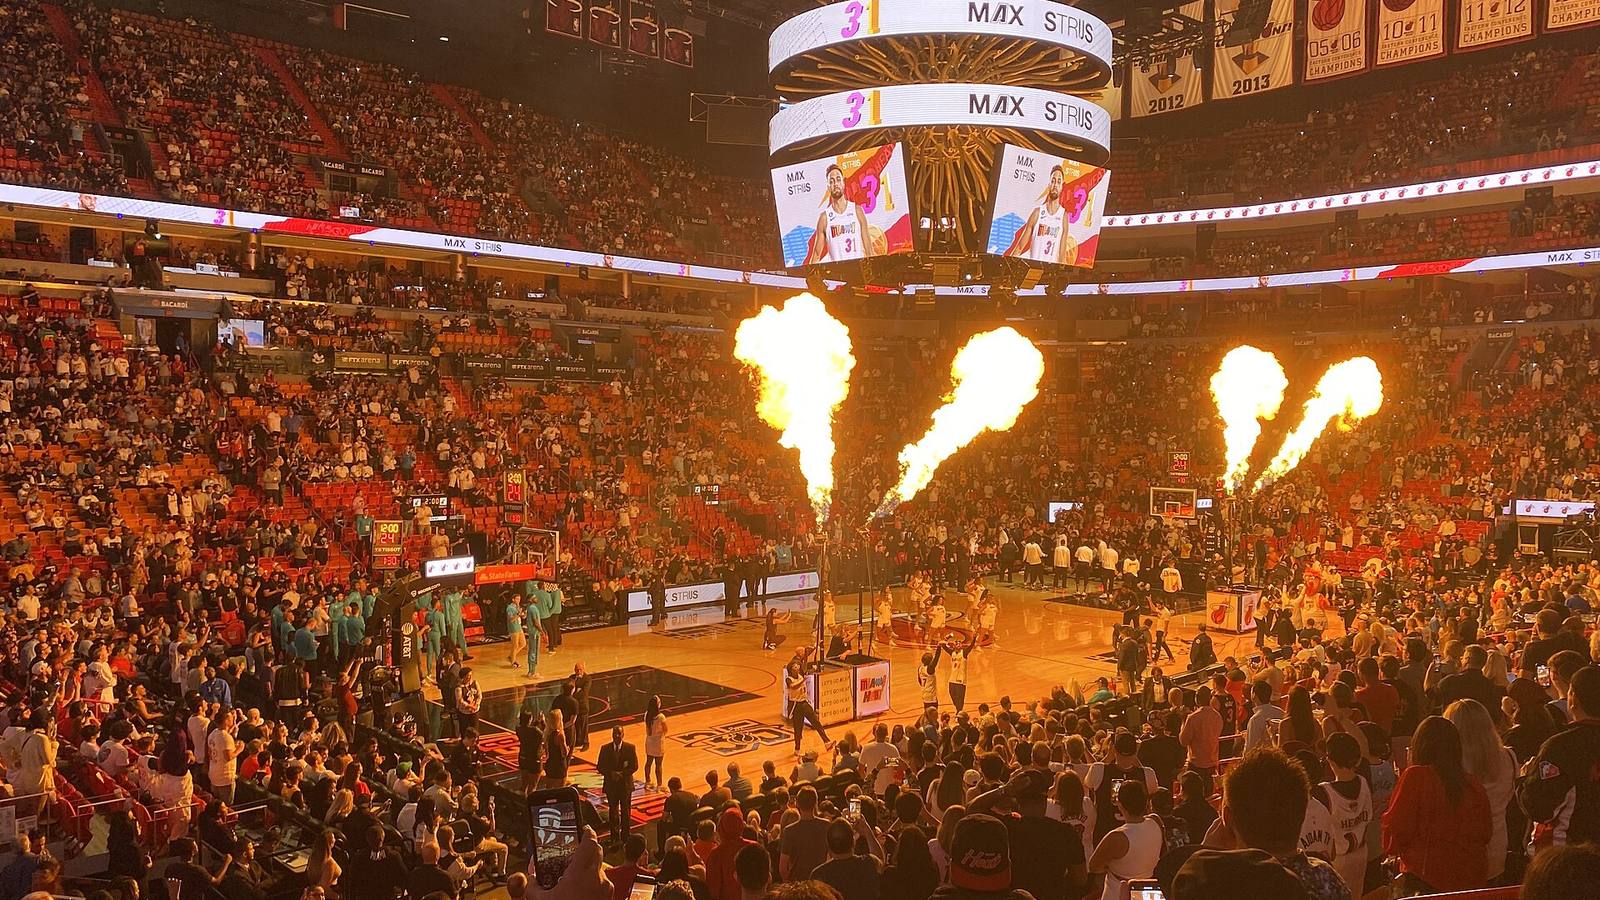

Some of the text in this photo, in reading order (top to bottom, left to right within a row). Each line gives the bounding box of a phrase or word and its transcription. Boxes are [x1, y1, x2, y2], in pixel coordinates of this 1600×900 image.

[841, 0, 880, 38] 31
[968, 2, 1093, 43] MAX STRUS
[1383, 21, 1403, 40] 10
[1463, 23, 1527, 42] CHAMPIONS
[1310, 31, 1361, 58] 05 06
[1381, 41, 1439, 60] CHAMPIONS
[1310, 58, 1362, 76] CHAMPIONS
[1232, 74, 1271, 95] 2013
[842, 90, 882, 128] 31
[969, 94, 1093, 130] MAX STRUS
[1149, 94, 1184, 113] 2012
[1016, 155, 1035, 168] MAX
[786, 170, 805, 183] MAX
[1013, 168, 1036, 183] STRUS
[787, 182, 811, 196] STRUS
[861, 174, 895, 214] 31
[1068, 186, 1097, 228] 31
[213, 208, 234, 226] 31
[444, 238, 502, 252] MAX STRUS
[1547, 252, 1573, 262] MAX
[508, 484, 521, 501] 24
[380, 532, 395, 544] 24
[671, 590, 699, 602] STRUS
[403, 636, 412, 658] AT&T
